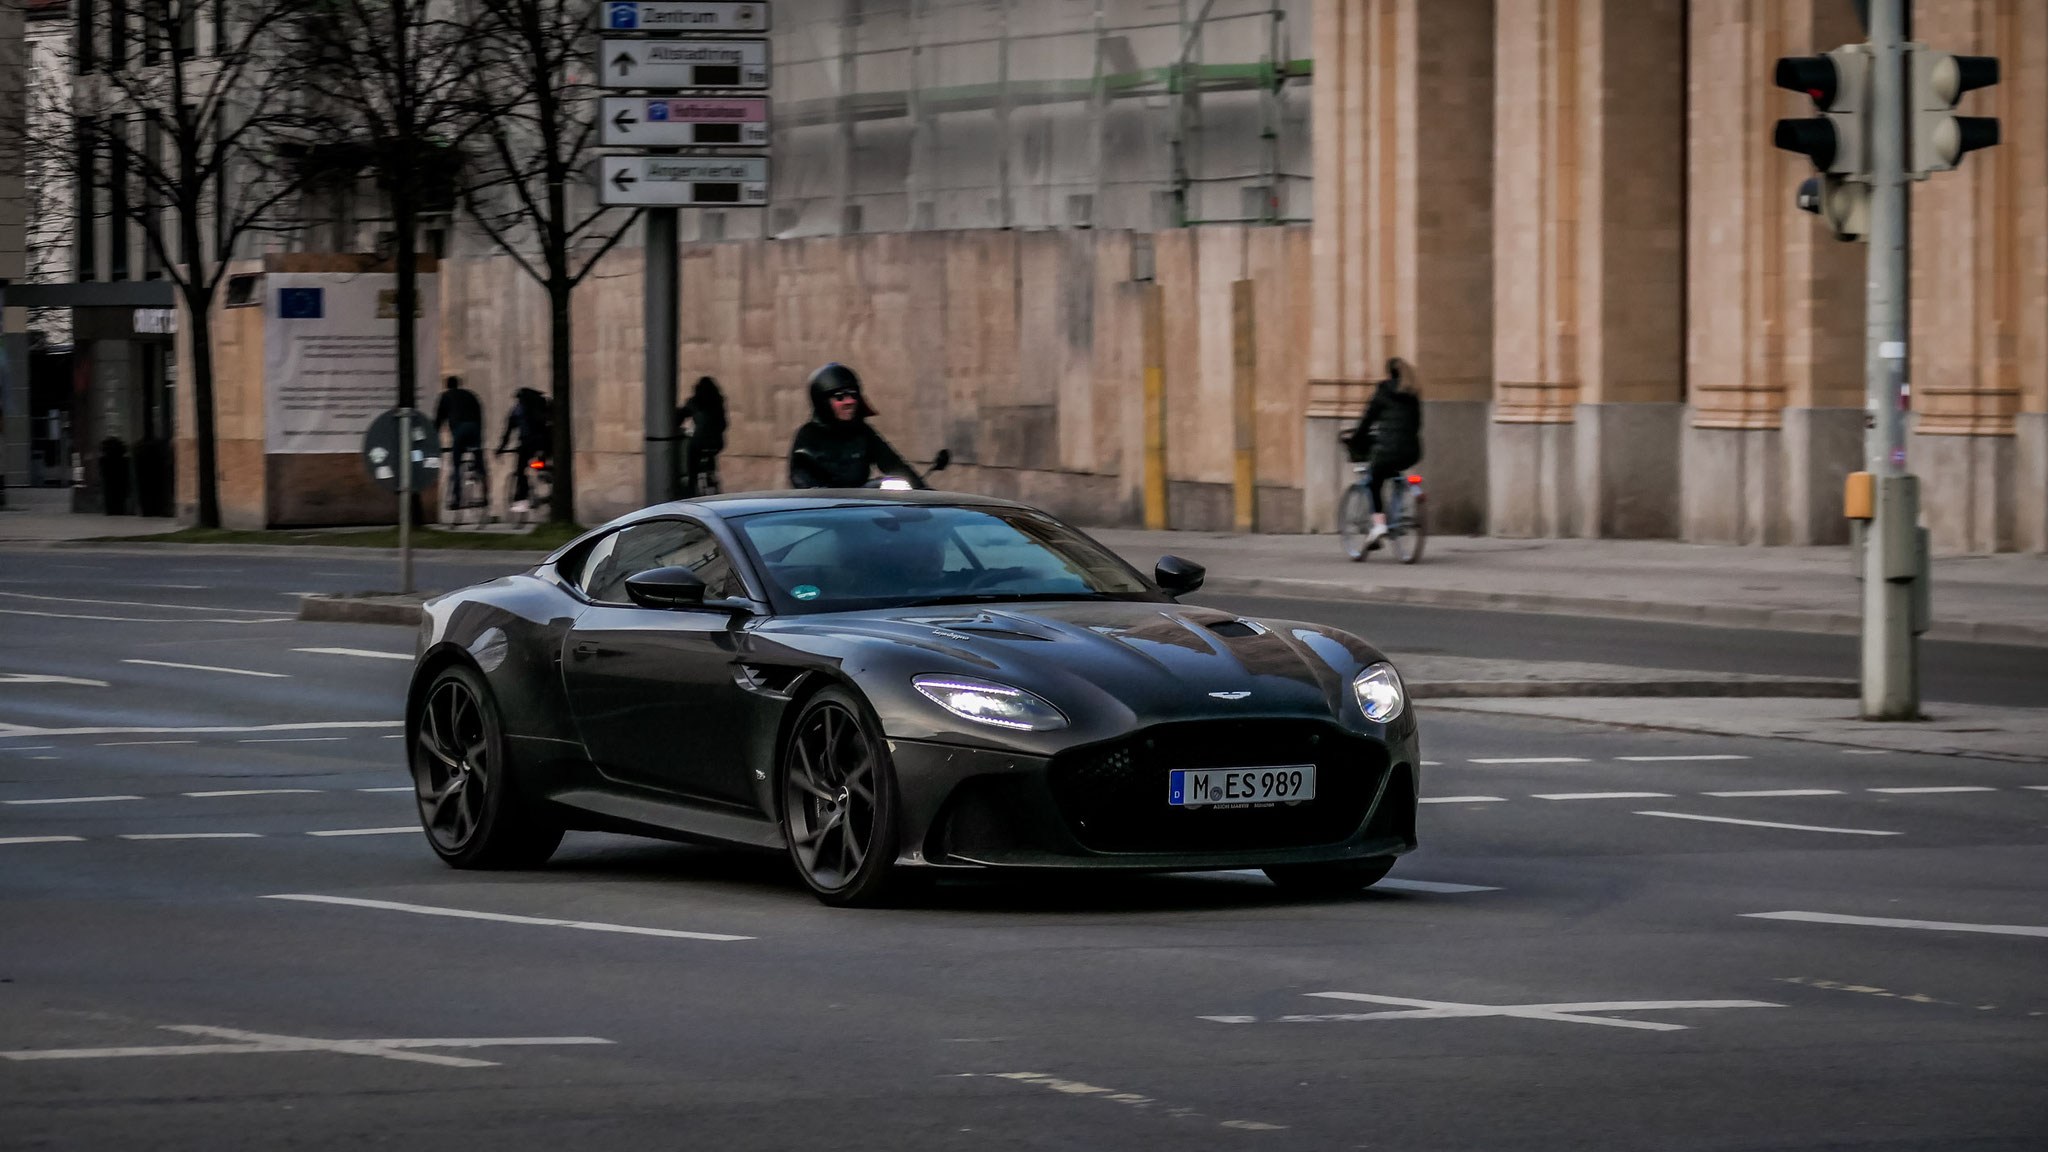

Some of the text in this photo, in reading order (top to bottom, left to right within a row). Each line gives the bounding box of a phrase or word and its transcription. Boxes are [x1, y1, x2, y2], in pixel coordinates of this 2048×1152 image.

[642, 7, 718, 24] Zentrum
[1174, 770, 1303, 800] D M ES 989
